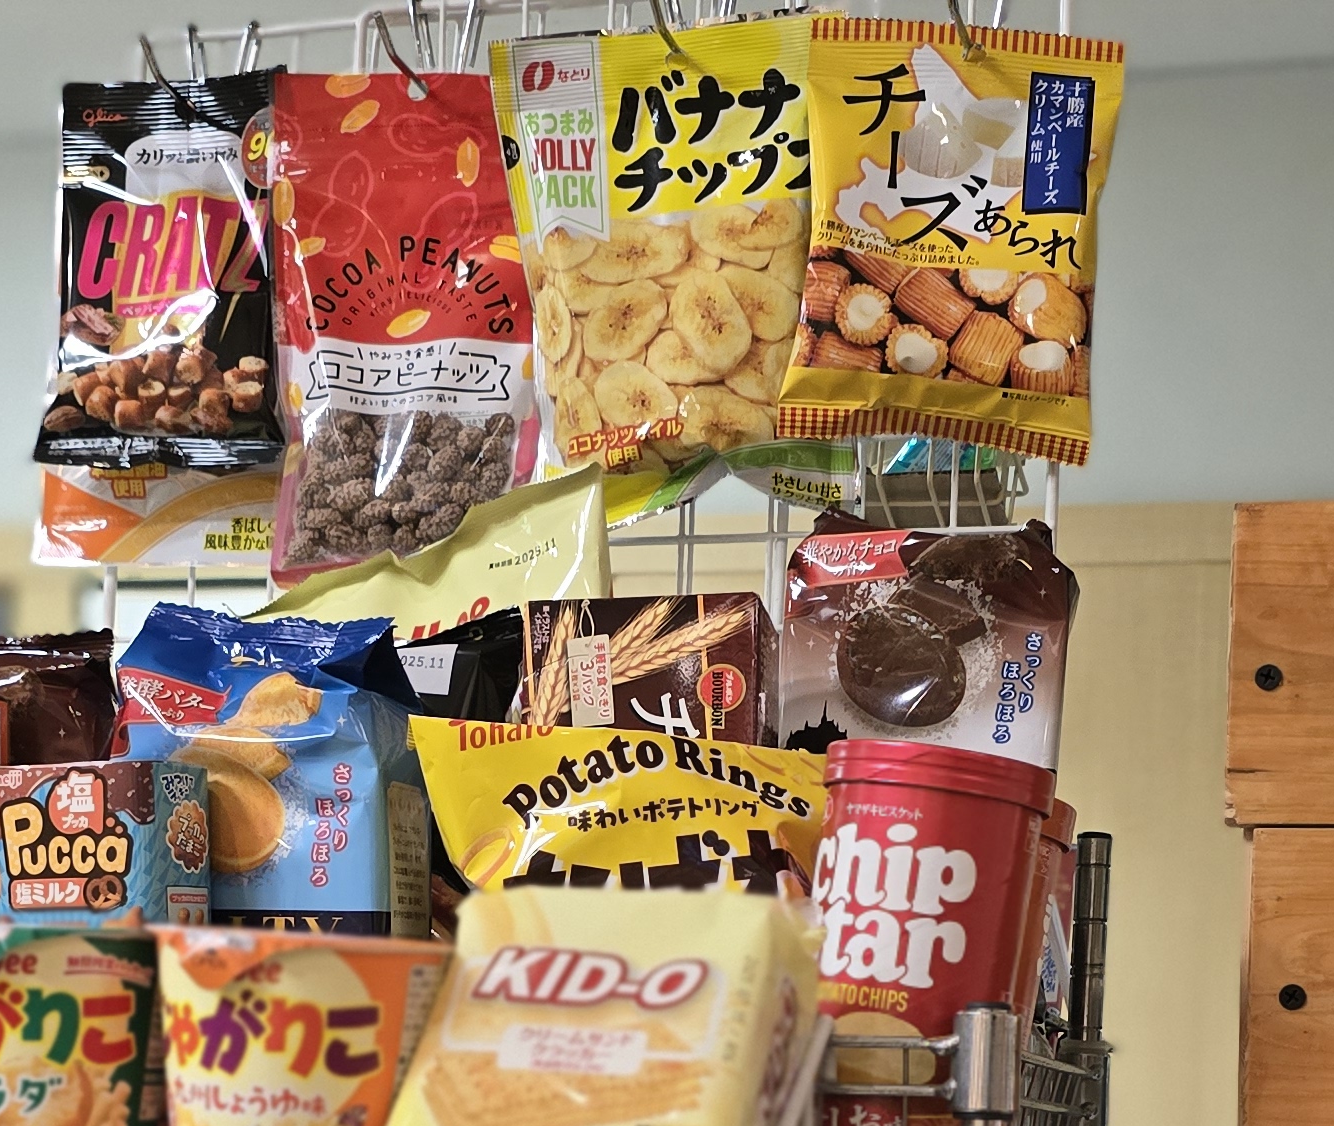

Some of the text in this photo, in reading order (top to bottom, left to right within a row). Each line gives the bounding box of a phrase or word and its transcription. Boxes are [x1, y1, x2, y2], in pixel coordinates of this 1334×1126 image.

[557, 69, 590, 82] なとり
[1066, 81, 1085, 128] 十勝産
[525, 110, 594, 136] おつまみ
[612, 68, 801, 152] バナナ
[531, 137, 596, 172] JOLLY
[842, 63, 987, 252] チーズ
[1043, 79, 1065, 206] カマンベールチーズ
[535, 175, 596, 209] PACK
[77, 196, 270, 299] CRATZ
[974, 199, 1082, 270] あられ
[306, 236, 514, 334] COCOA PEANUTS
[323, 359, 490, 388] ココアピーナッツ
[567, 416, 684, 455] ココナッツオイル
[606, 446, 640, 467] 使用
[772, 472, 843, 499] やさしい甘さ
[710, 670, 725, 729] BOURBON
[1019, 632, 1044, 713] さっくり
[992, 661, 1020, 744] ほろほろ
[449, 718, 555, 751] Tohato
[56, 772, 96, 814] 塩
[331, 762, 353, 852] さっくり
[502, 735, 811, 830] Potato Rings
[2, 801, 129, 877] Pucca
[61, 814, 89, 830] プッカ
[309, 797, 336, 888] ほろほろ
[567, 797, 760, 833] 味わいポテトリング
[15, 881, 81, 906] 塩ミルク
[812, 822, 978, 916] chip
[819, 898, 967, 990] tar
[473, 946, 709, 1010] KID-O
[860, 986, 909, 1013] CHIPS
